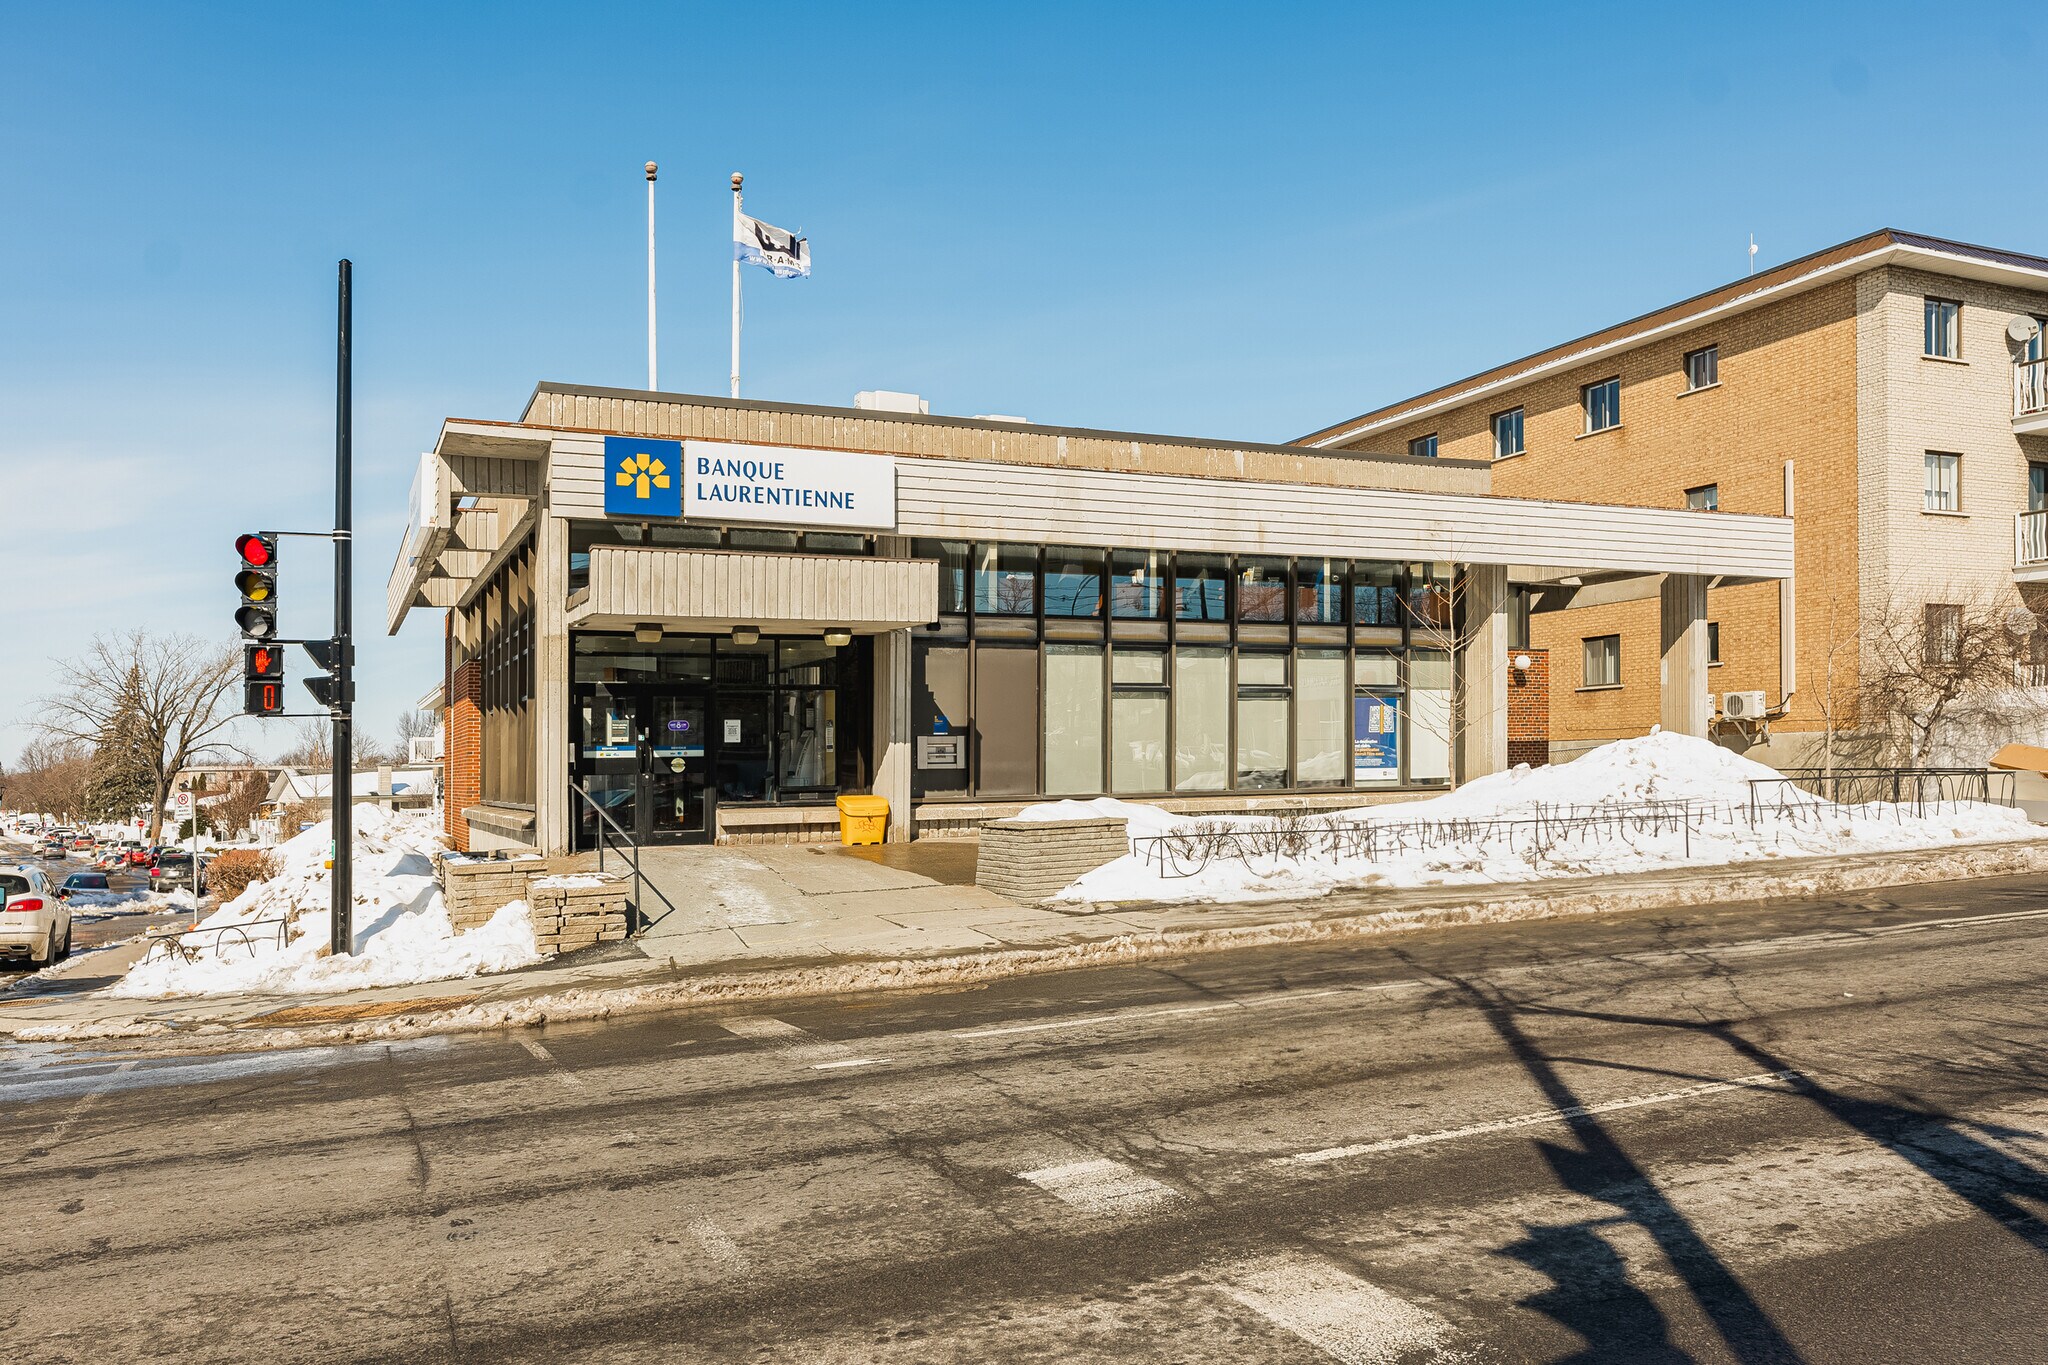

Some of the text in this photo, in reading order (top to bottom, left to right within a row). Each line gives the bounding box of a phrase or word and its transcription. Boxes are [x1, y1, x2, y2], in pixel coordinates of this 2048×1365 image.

[697, 457, 784, 482] BANQUE
[697, 482, 855, 510] LAURENTIENNE
[263, 685, 275, 710] 0
